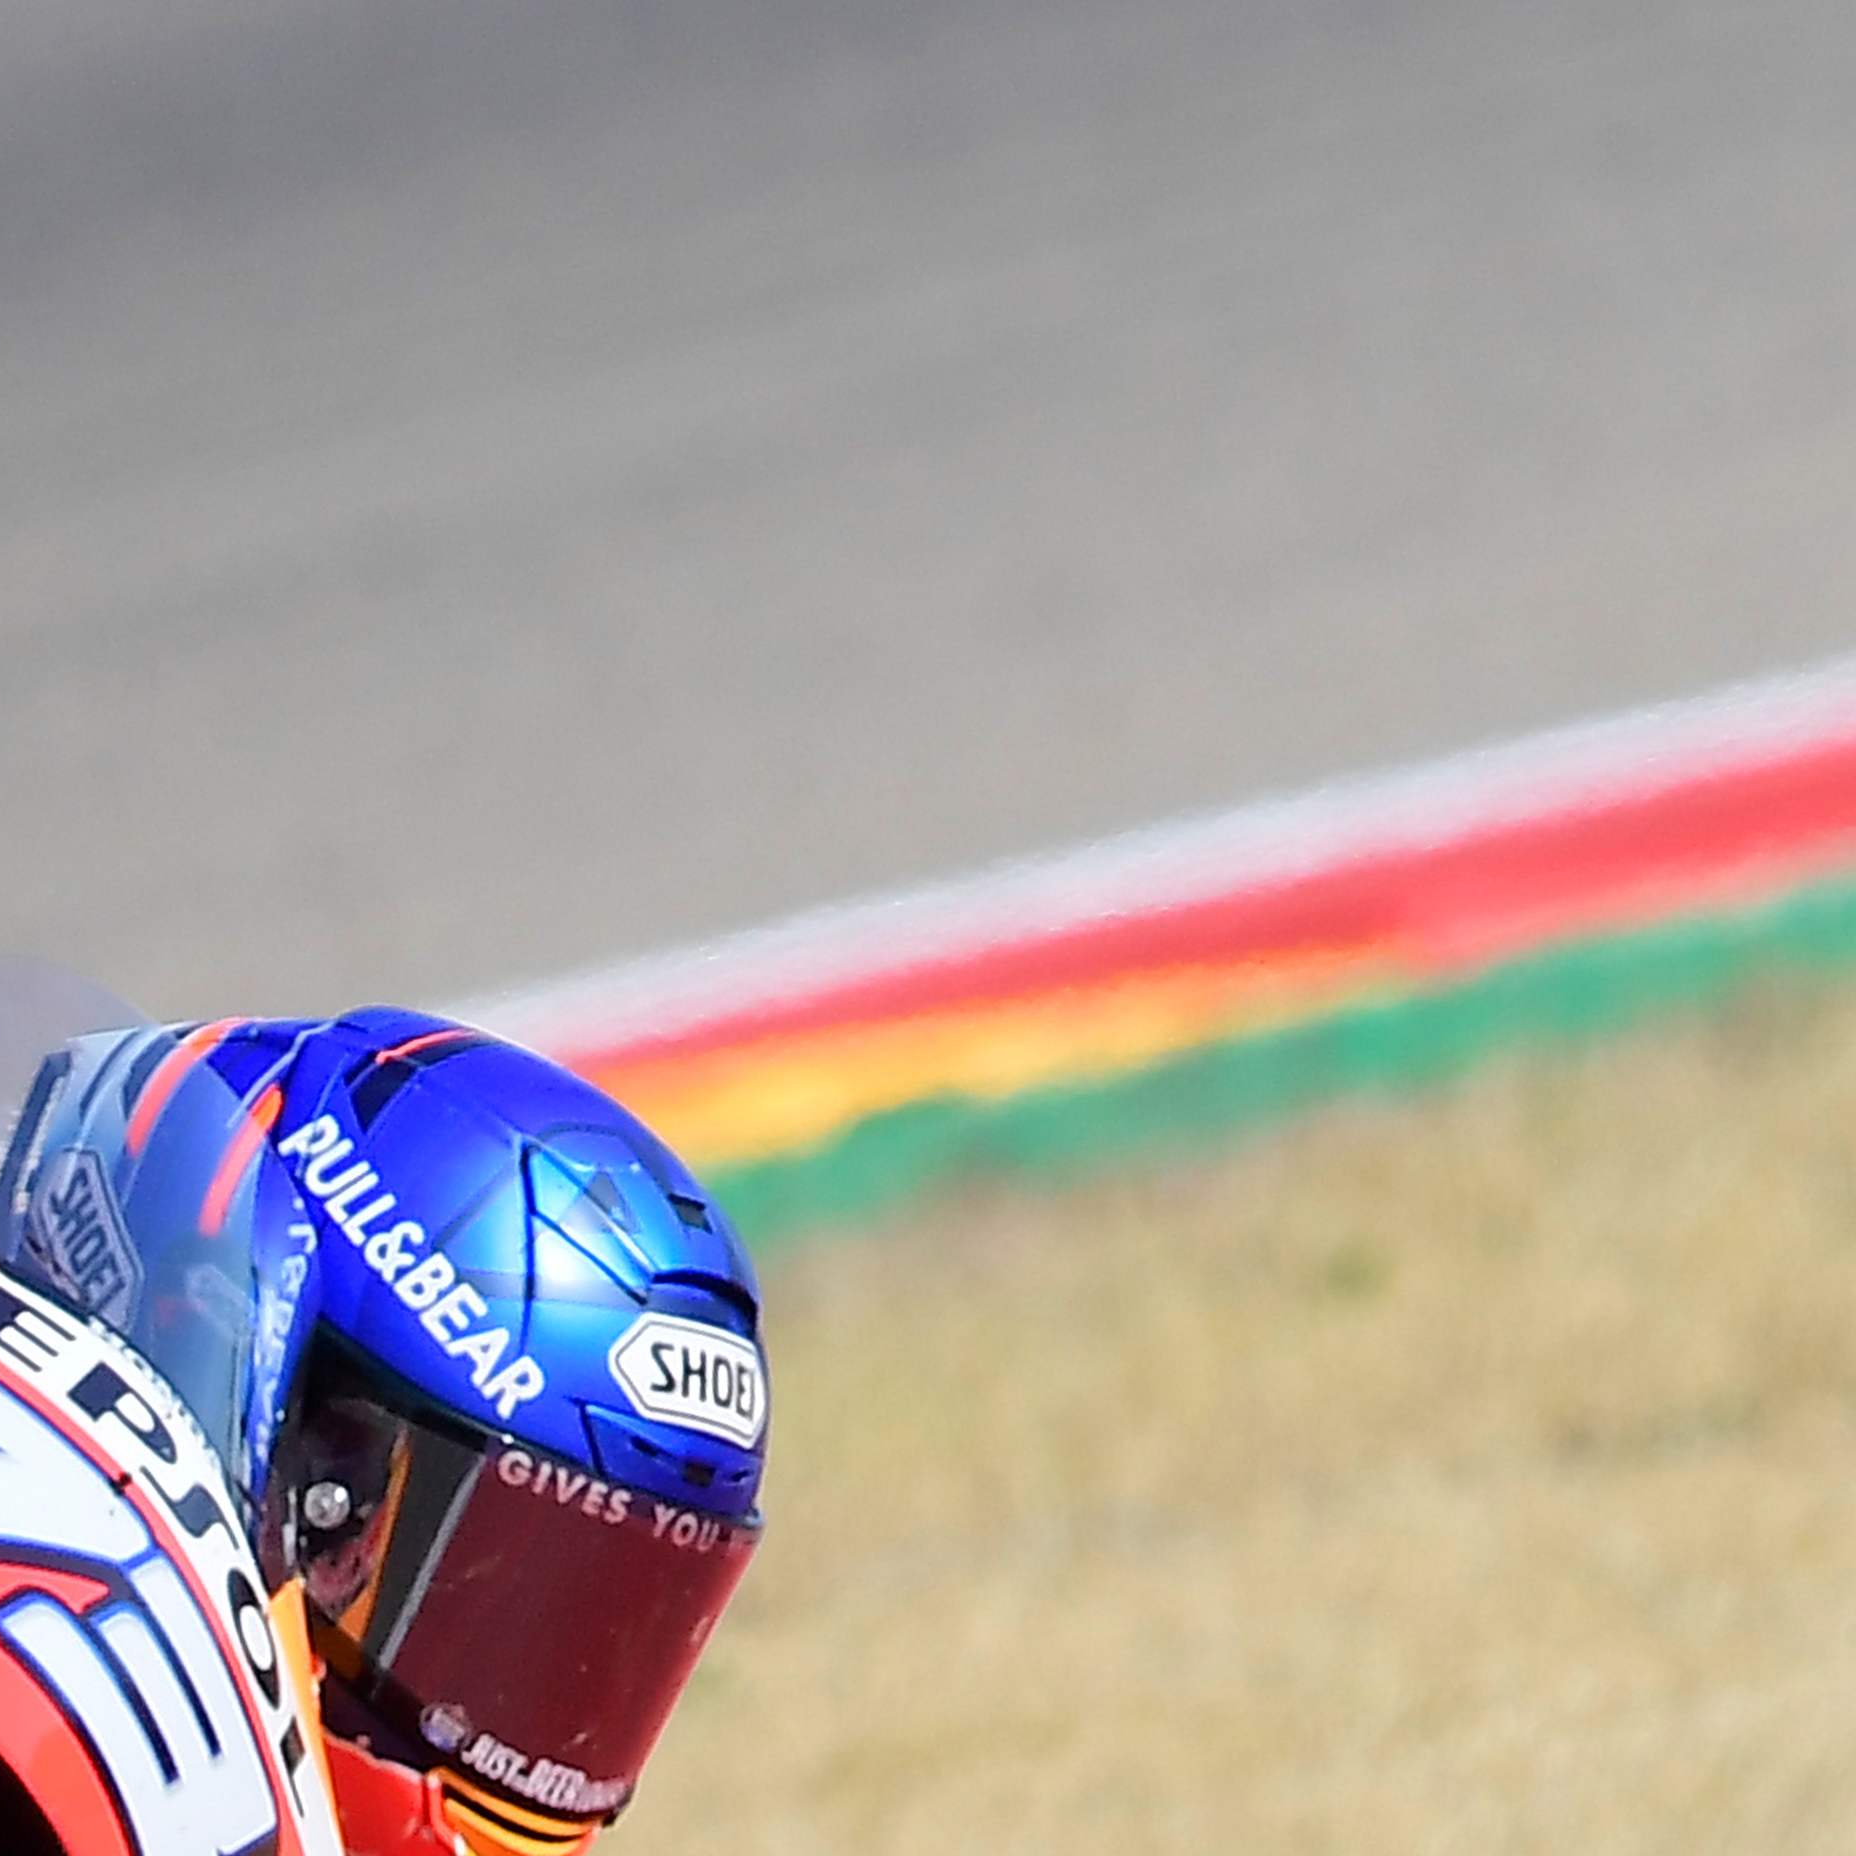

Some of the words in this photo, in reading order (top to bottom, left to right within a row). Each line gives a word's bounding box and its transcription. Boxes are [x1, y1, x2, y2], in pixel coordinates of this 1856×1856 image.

[277, 1113, 545, 1421] PULL&BEAR
[497, 1450, 633, 1524] GIVES
[652, 1502, 720, 1552] YOU
